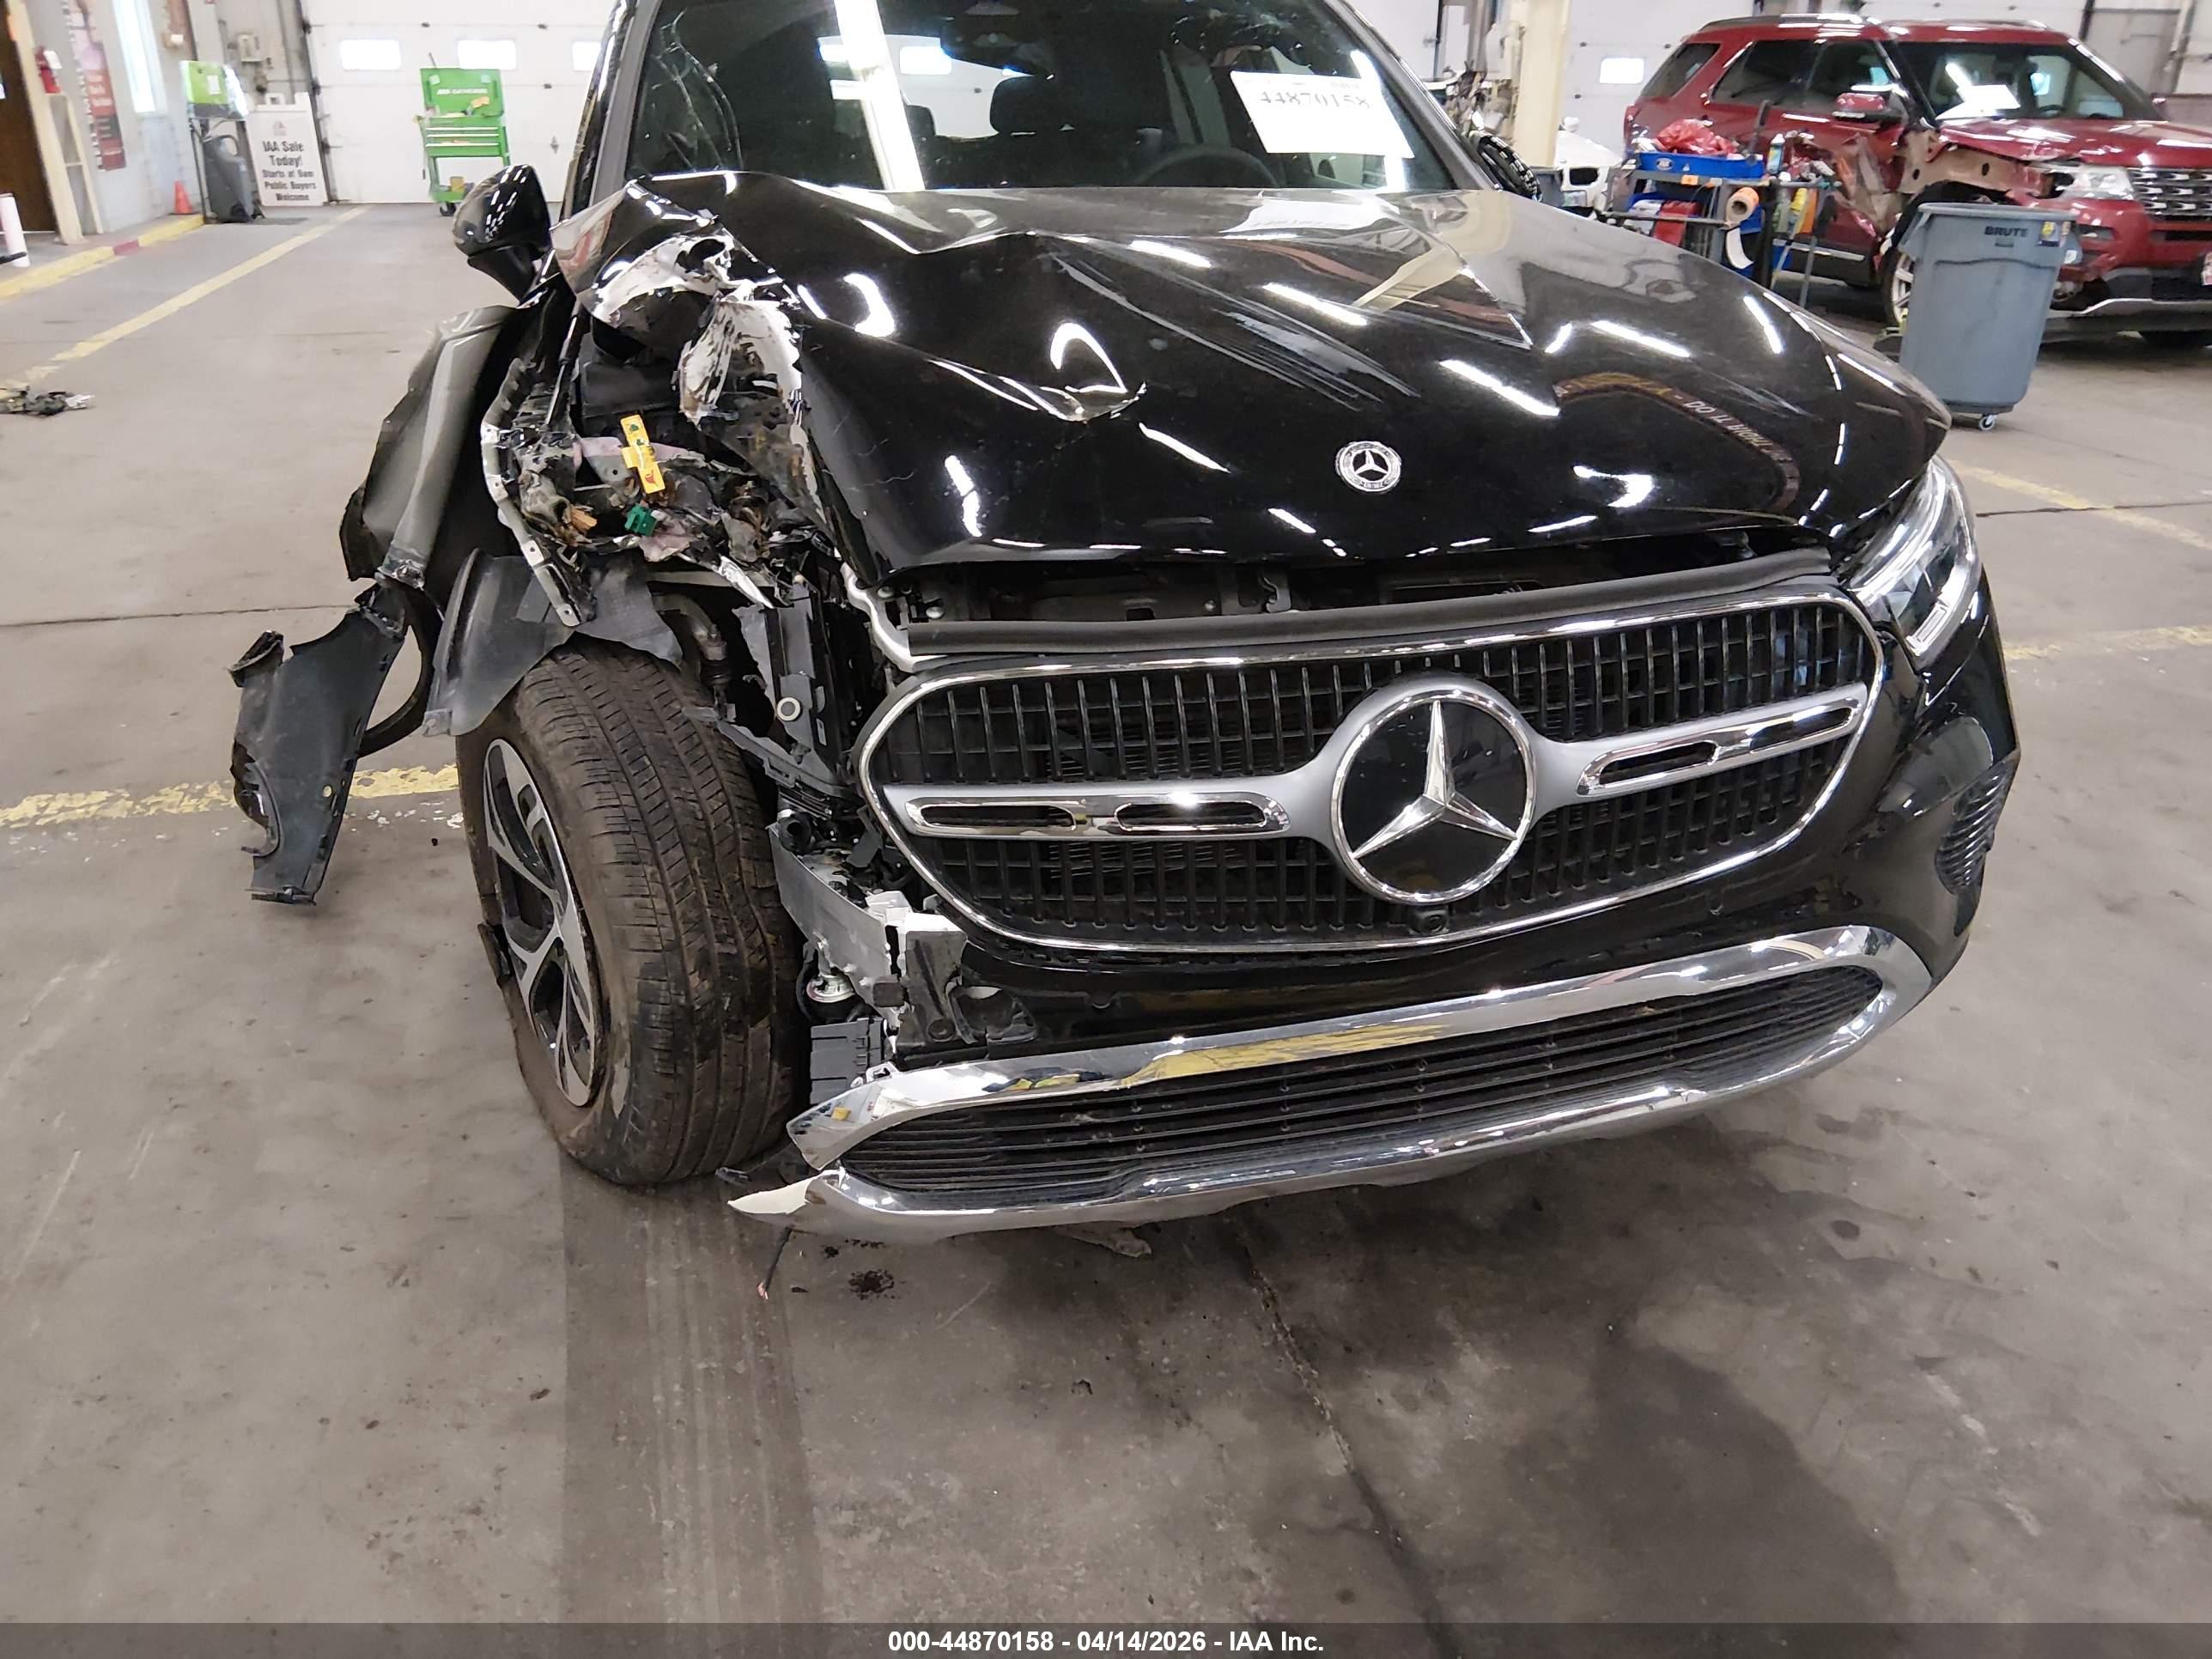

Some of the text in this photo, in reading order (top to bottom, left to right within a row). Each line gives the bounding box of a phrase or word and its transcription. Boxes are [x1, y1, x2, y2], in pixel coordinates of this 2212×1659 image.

[262, 141, 304, 152] IAA Sale
[264, 181, 316, 191] Public Buyers
[276, 192, 309, 201] Welcome
[1984, 226, 2028, 237] BRUTE
